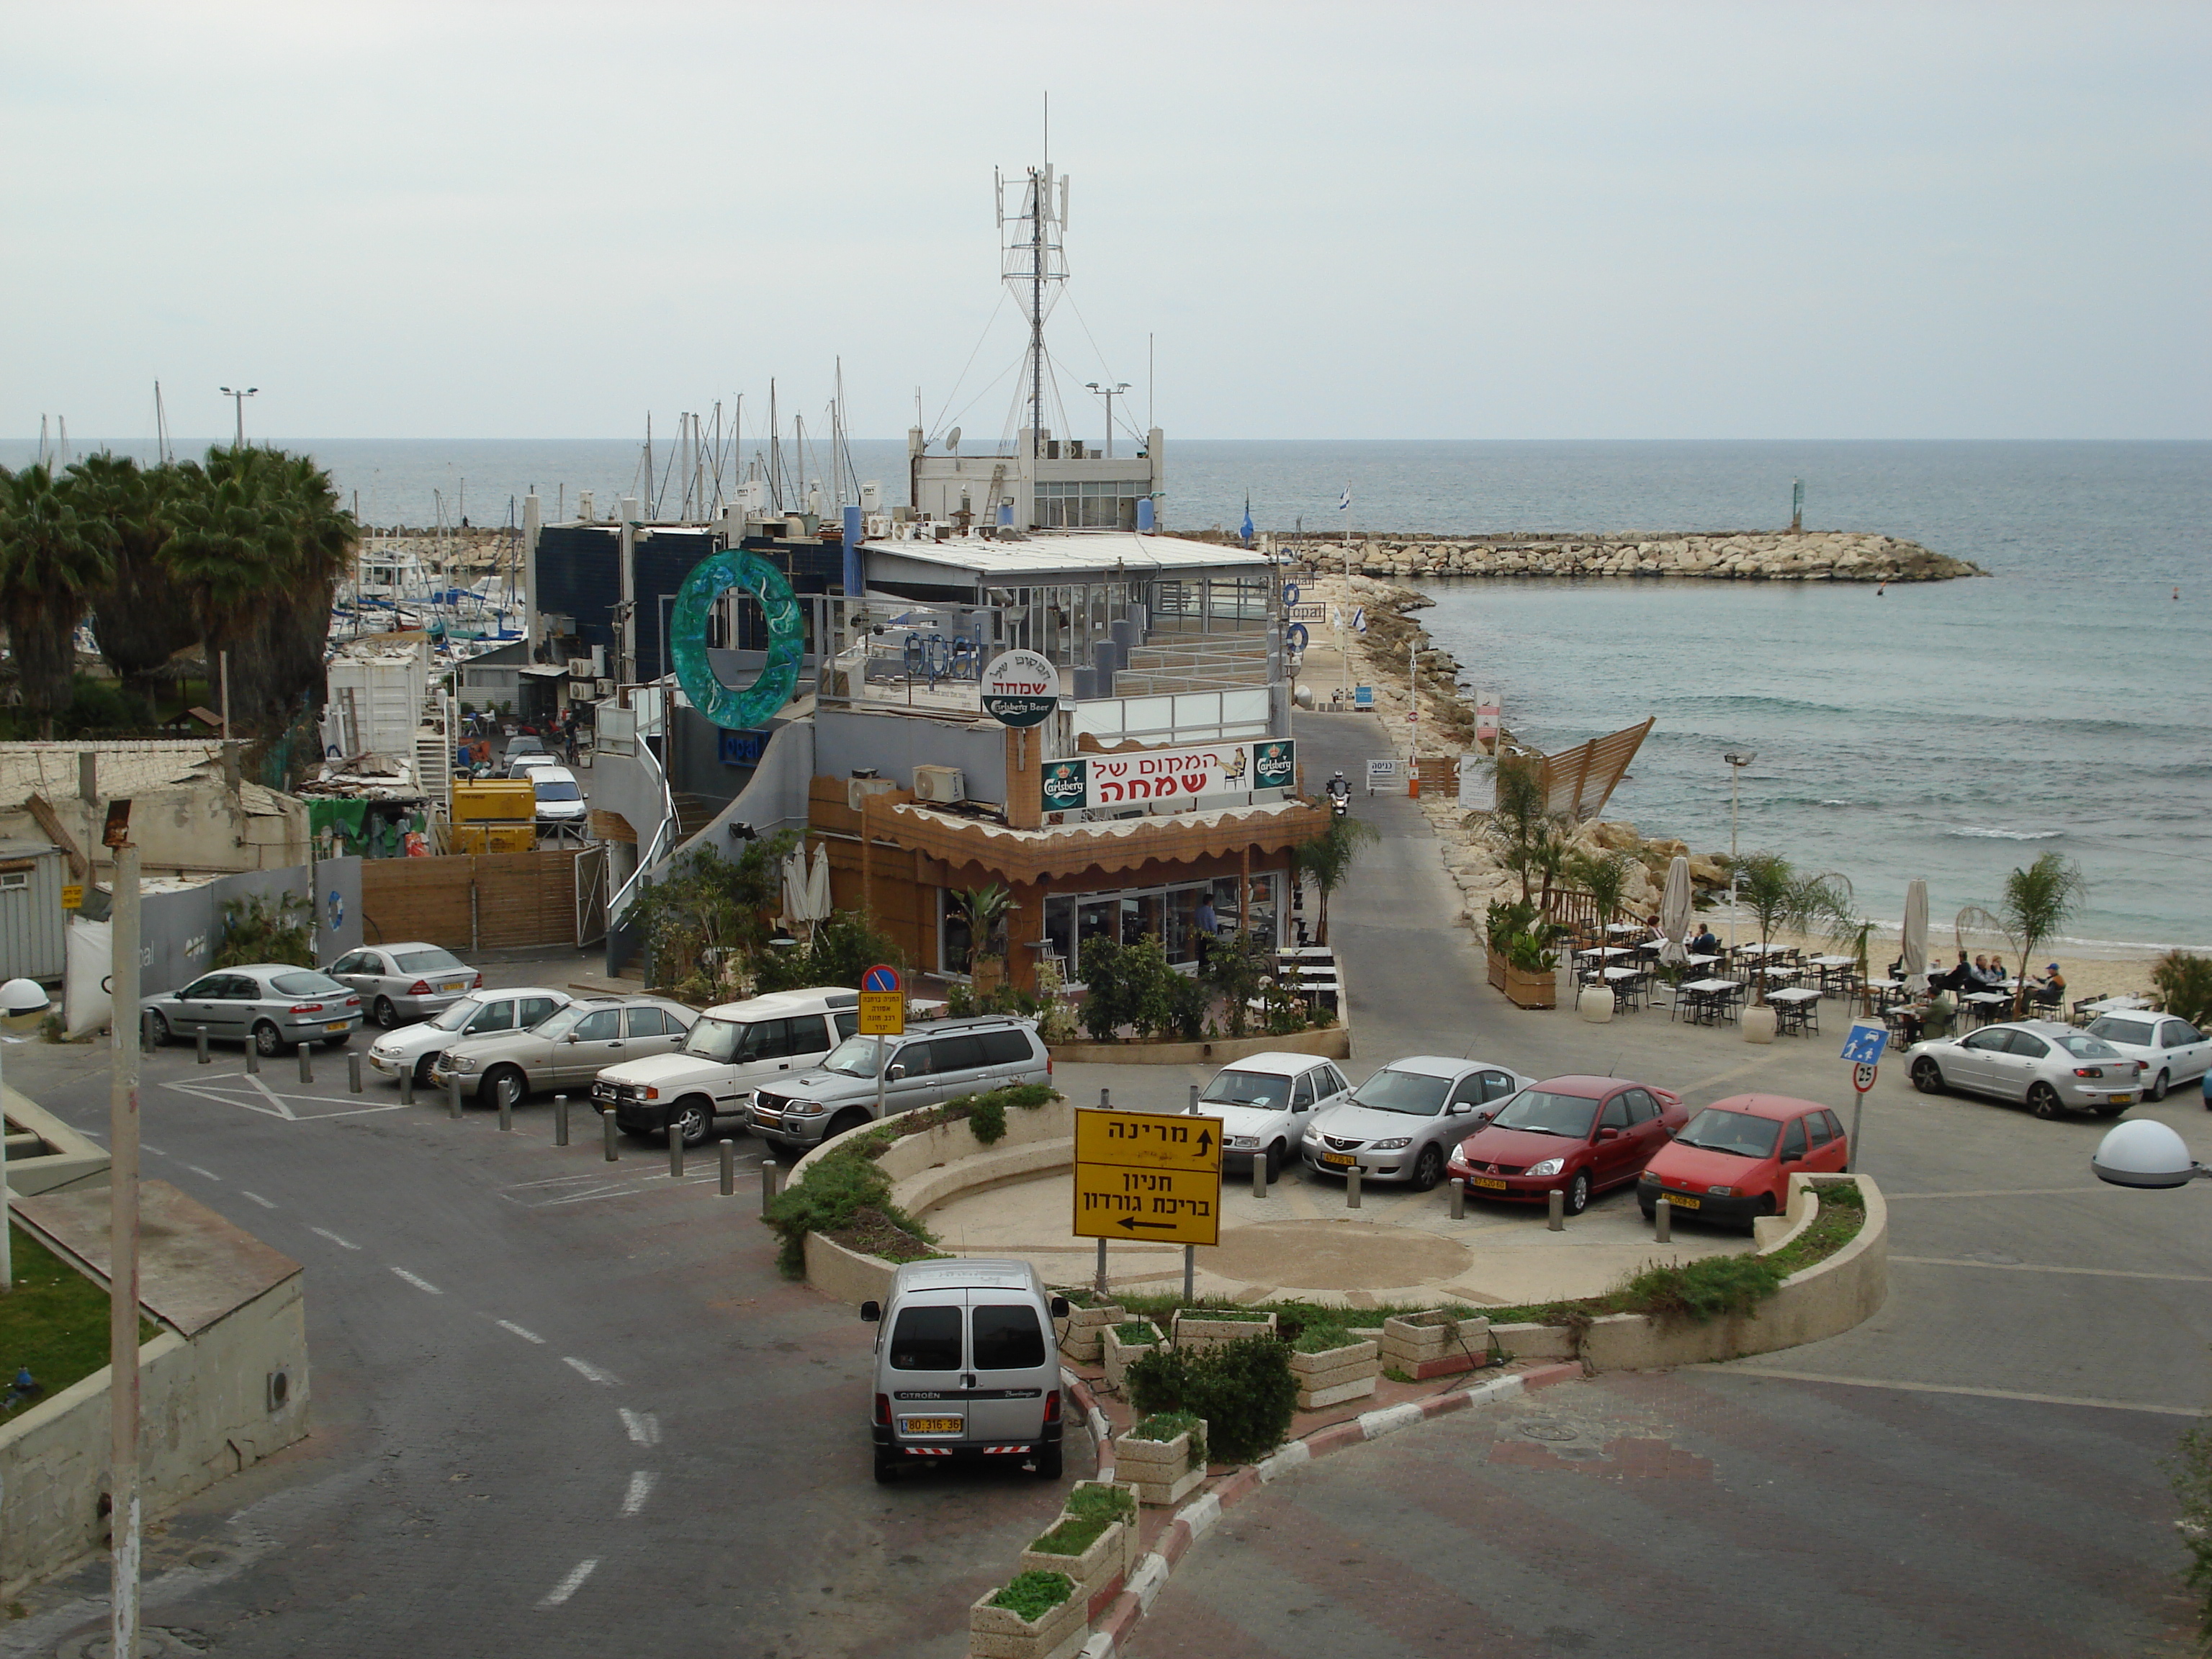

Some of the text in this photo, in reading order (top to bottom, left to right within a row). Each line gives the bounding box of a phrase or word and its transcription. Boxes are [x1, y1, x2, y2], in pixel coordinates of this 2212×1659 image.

[1293, 605, 1321, 621] opal
[904, 624, 983, 691] opal
[989, 656, 1051, 680] המקום של
[992, 681, 1047, 695] שמחה
[991, 700, 1049, 714] Carlsberg Beer
[727, 736, 760, 761] opal
[1092, 753, 1218, 779] המקום של
[1257, 756, 1292, 774] Carlsberg
[1044, 777, 1084, 794] Carlsberg
[1100, 773, 1208, 804] שמחה
[1858, 1067, 1872, 1082] 25
[1109, 1122, 1188, 1143] מרינה
[1123, 1173, 1172, 1192] חניון
[1083, 1192, 1210, 1217] בריכת גורדון
